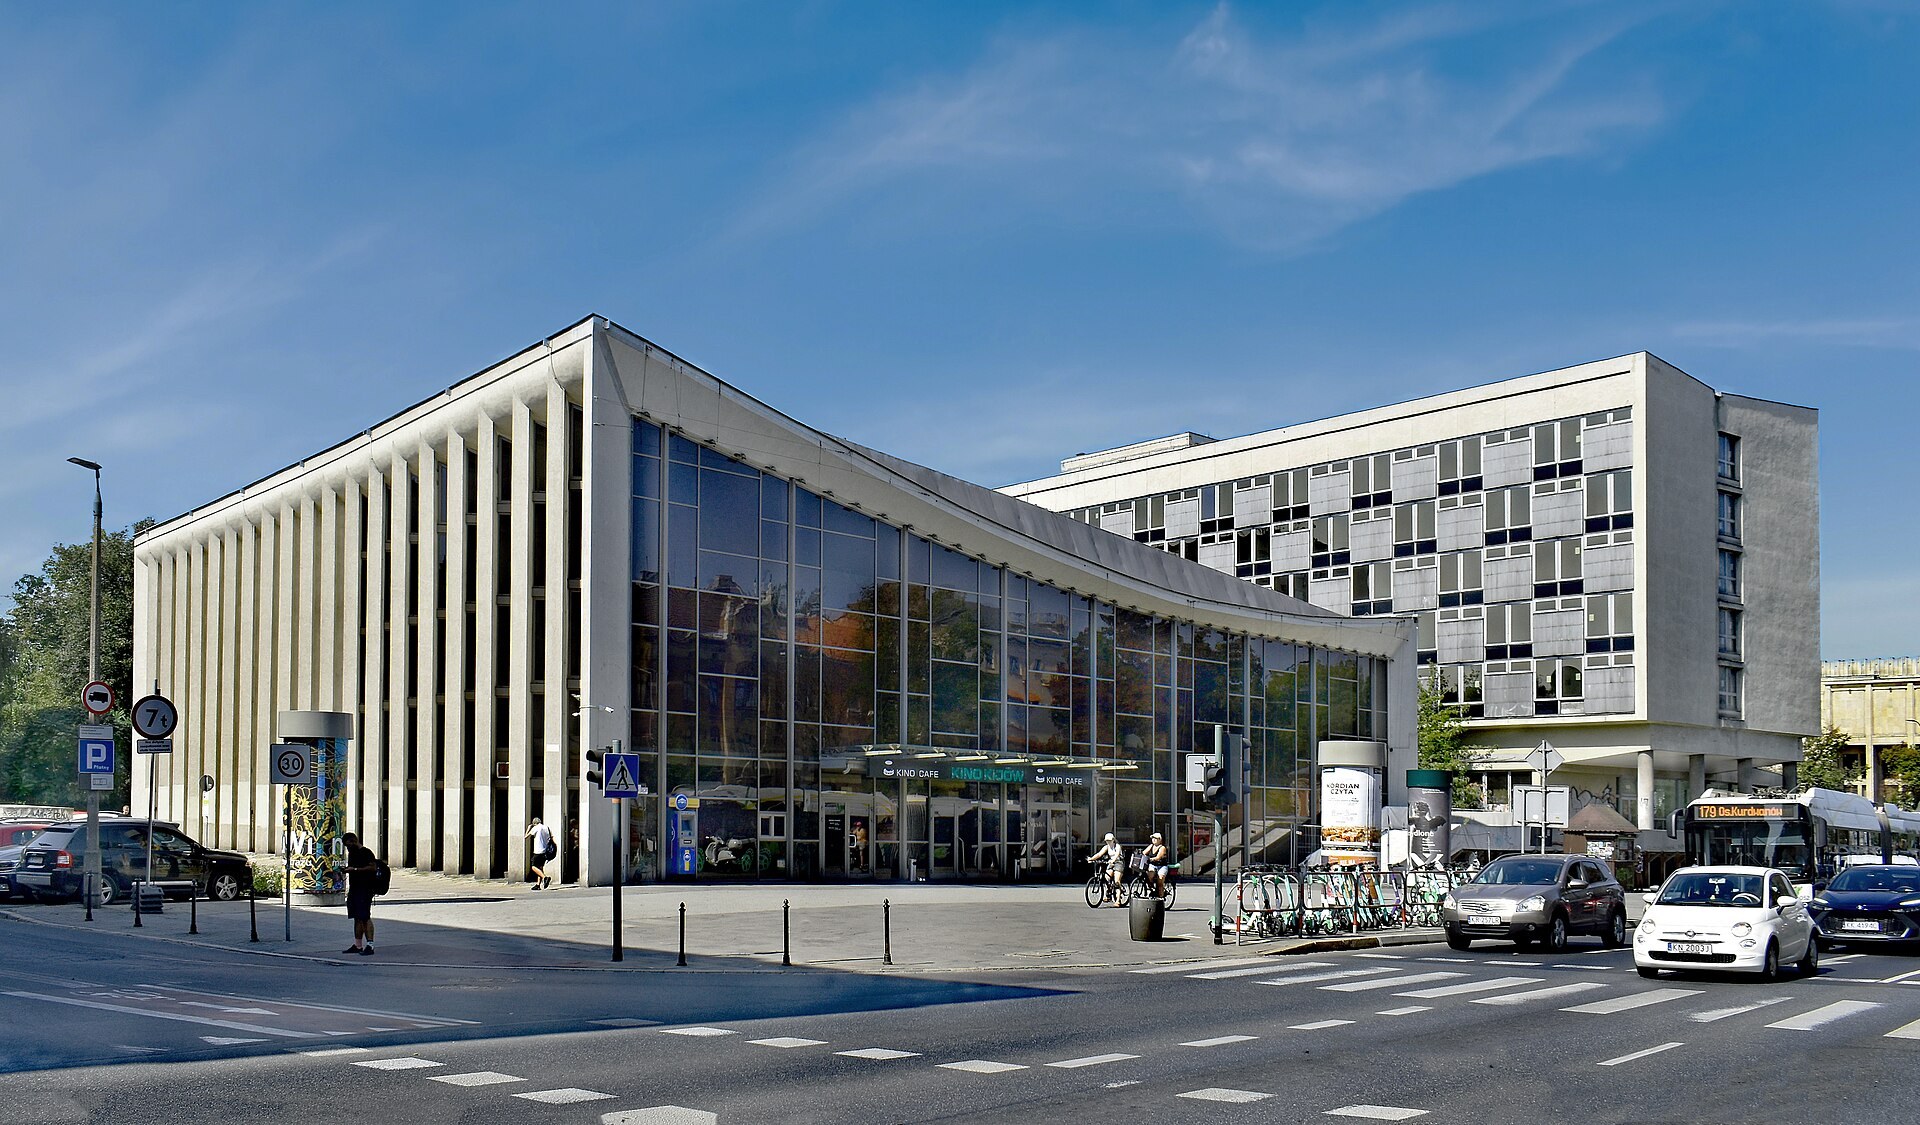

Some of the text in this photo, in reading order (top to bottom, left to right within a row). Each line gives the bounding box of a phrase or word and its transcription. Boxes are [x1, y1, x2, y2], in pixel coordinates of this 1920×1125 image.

[86, 743, 107, 769] P
[281, 757, 301, 771] 30
[896, 769, 939, 779] KINO CAFE
[951, 766, 982, 780] KINO
[1046, 776, 1083, 786] KINO CAFE
[1699, 805, 1717, 818] 179
[1672, 943, 1684, 951] KN
